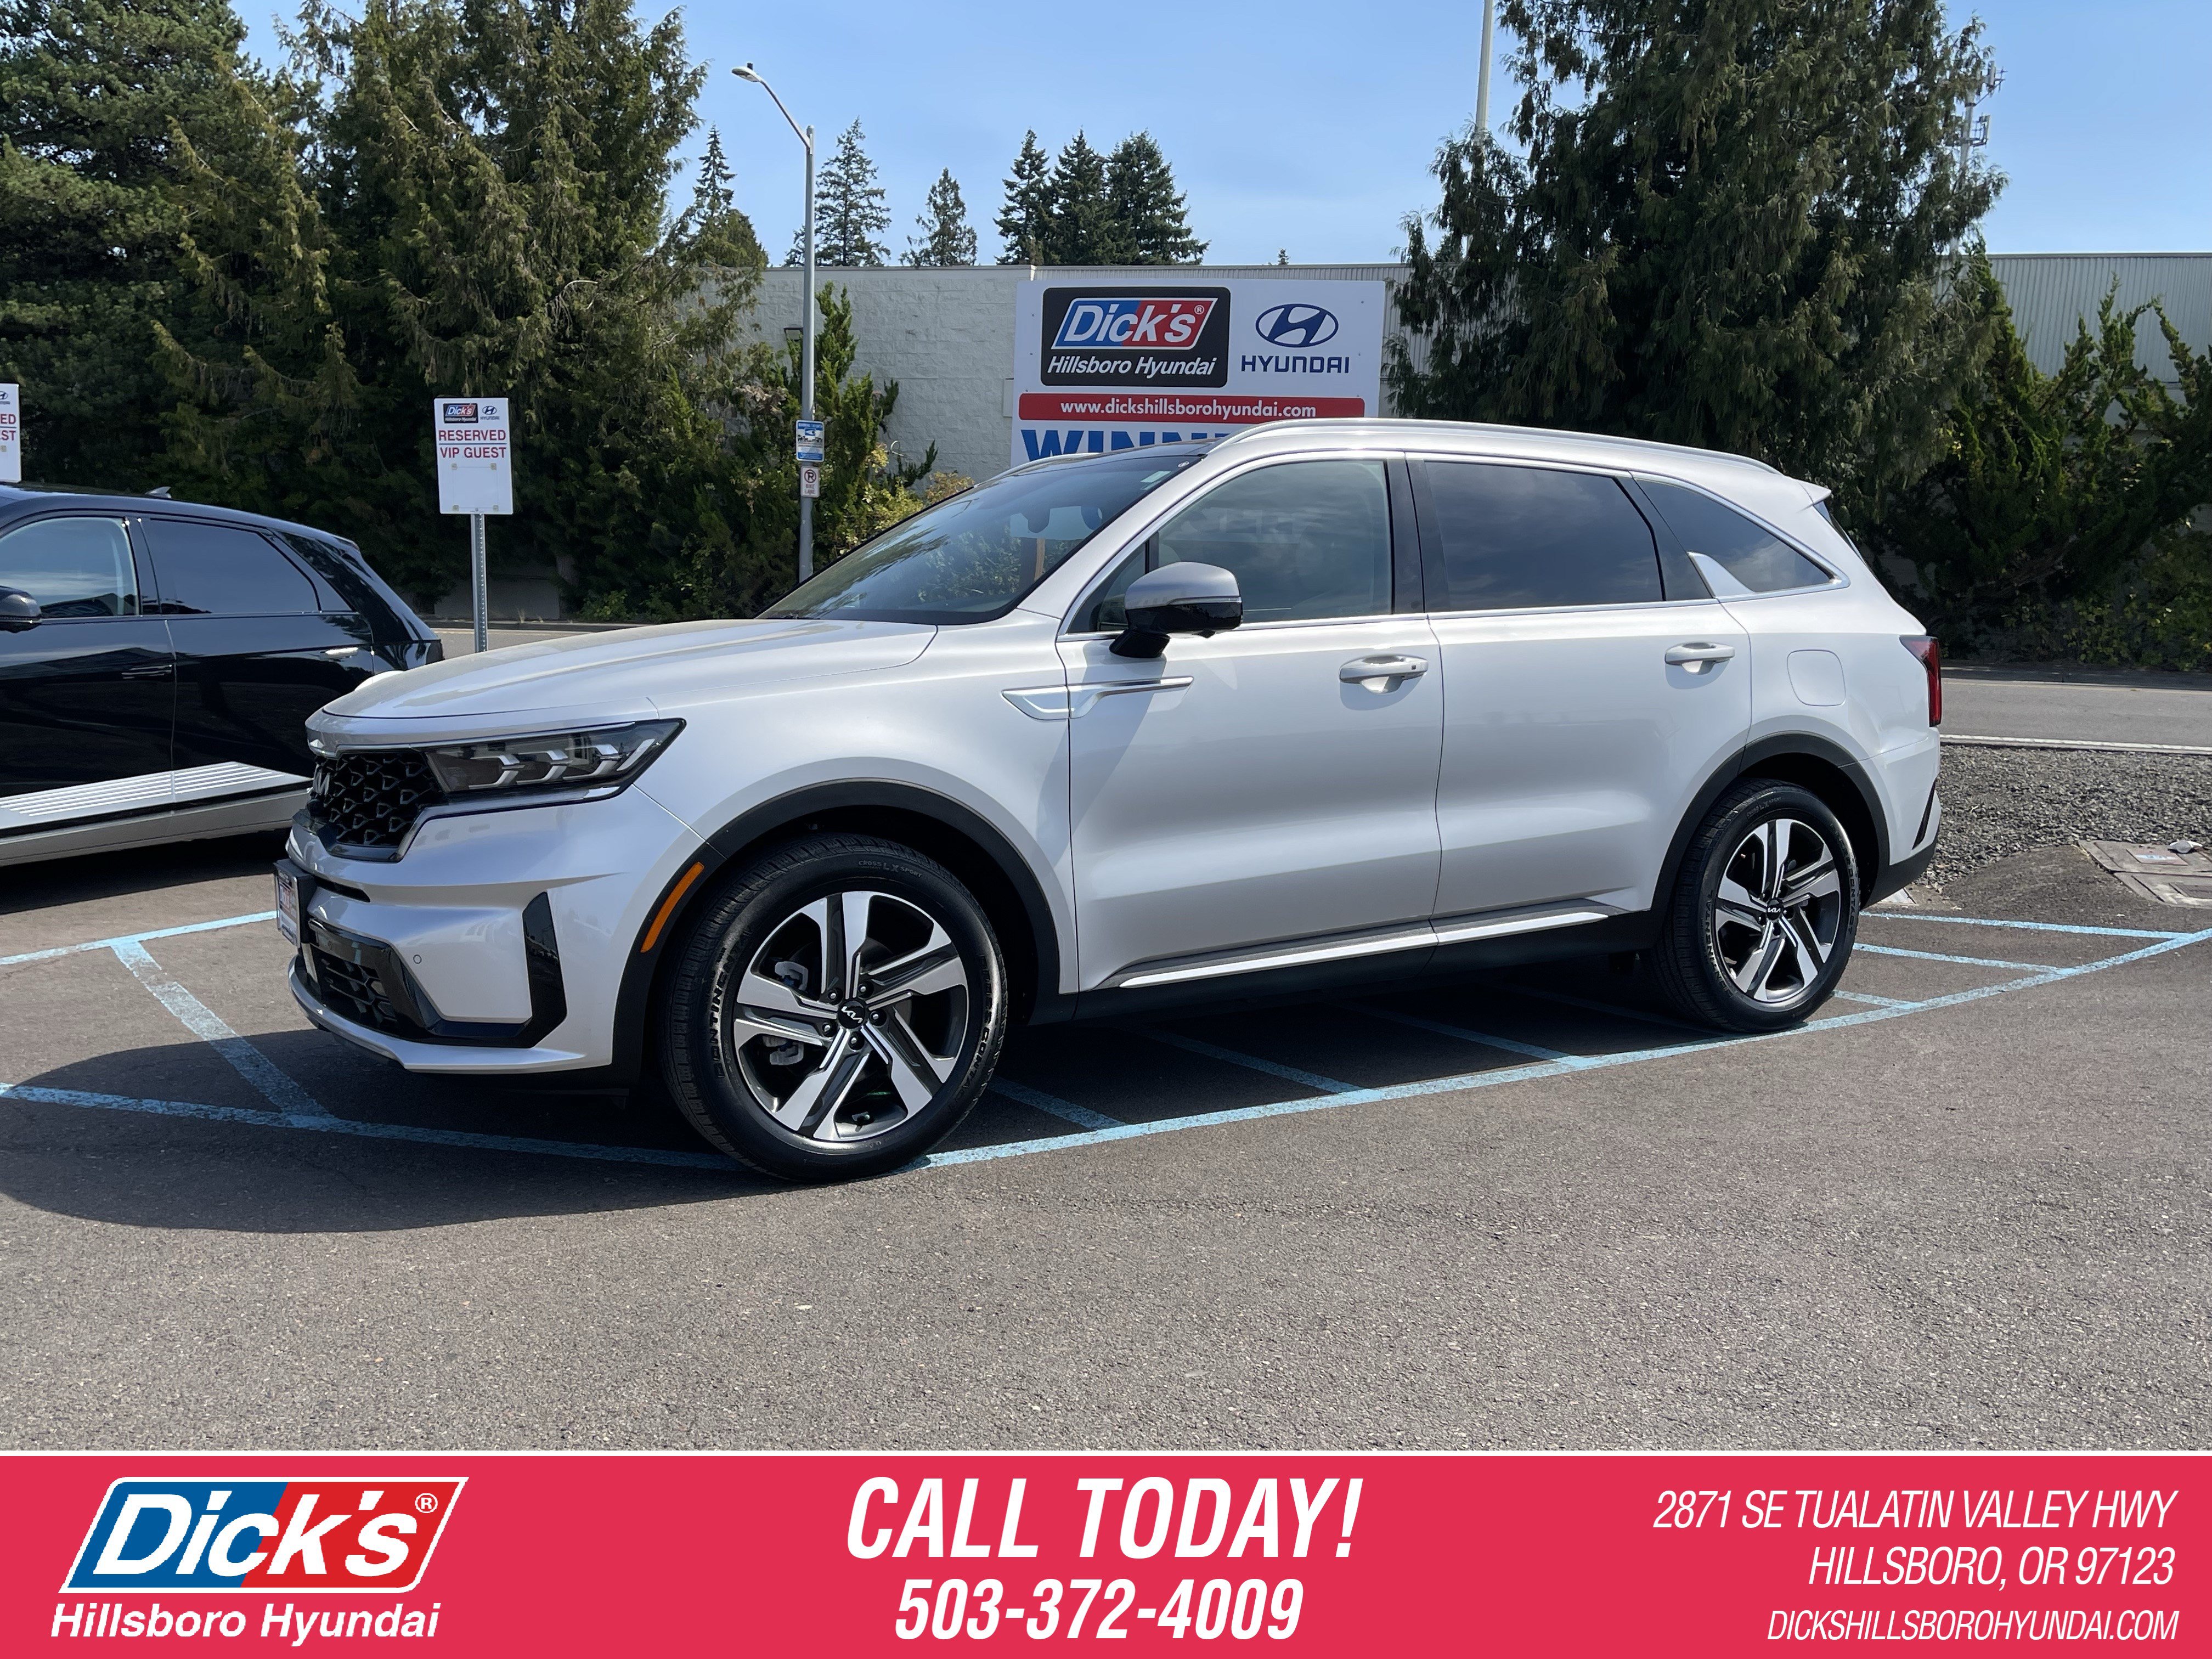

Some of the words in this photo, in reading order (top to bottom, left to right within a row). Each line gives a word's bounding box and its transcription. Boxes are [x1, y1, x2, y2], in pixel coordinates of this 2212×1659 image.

[1047, 356, 1132, 374] Hillsboro
[1135, 357, 1217, 379] Hyundai
[1241, 354, 1350, 374] HYUNDAI
[1060, 397, 1317, 420] www.dickshillsborohyundai.com
[0, 430, 16, 441] ST
[438, 430, 506, 441] RESERVED
[440, 447, 460, 458] VIP
[464, 447, 507, 459] GUEST
